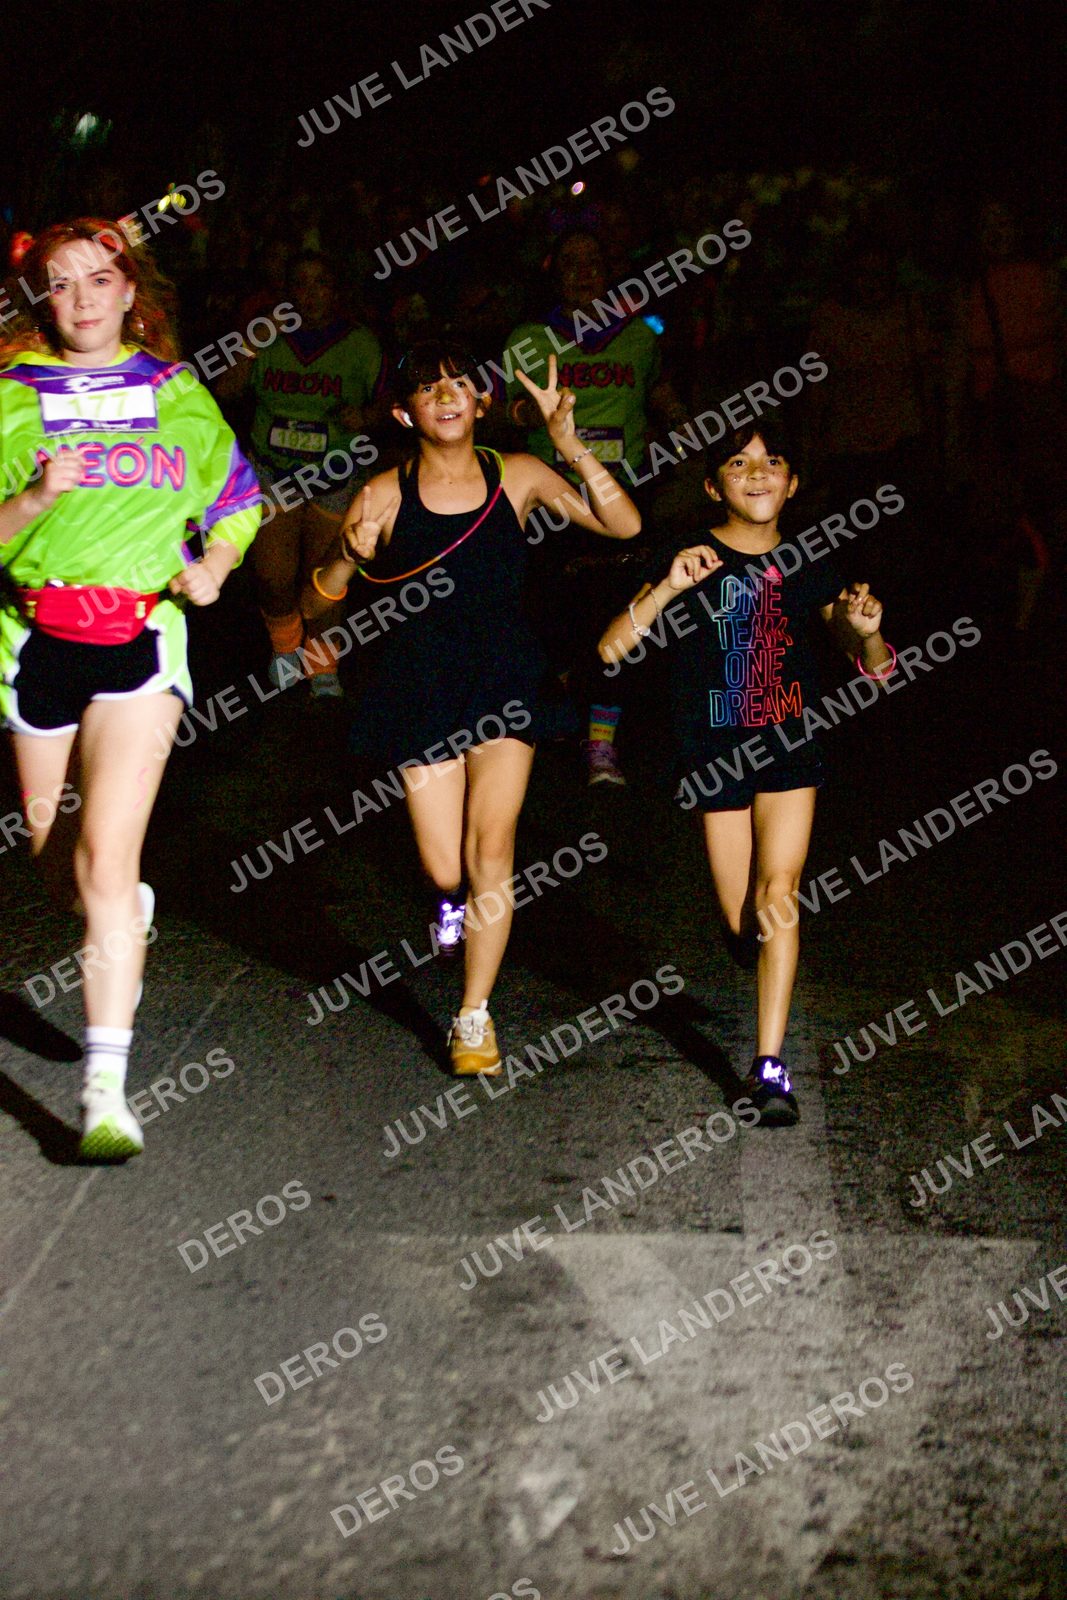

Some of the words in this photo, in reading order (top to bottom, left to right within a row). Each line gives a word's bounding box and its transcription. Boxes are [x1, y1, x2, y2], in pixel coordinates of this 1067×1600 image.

[68, 391, 129, 418] 177
[37, 437, 187, 491] EÓN
[721, 575, 782, 616] ONE
[725, 648, 785, 688] ONE
[709, 682, 802, 727] DREAM
